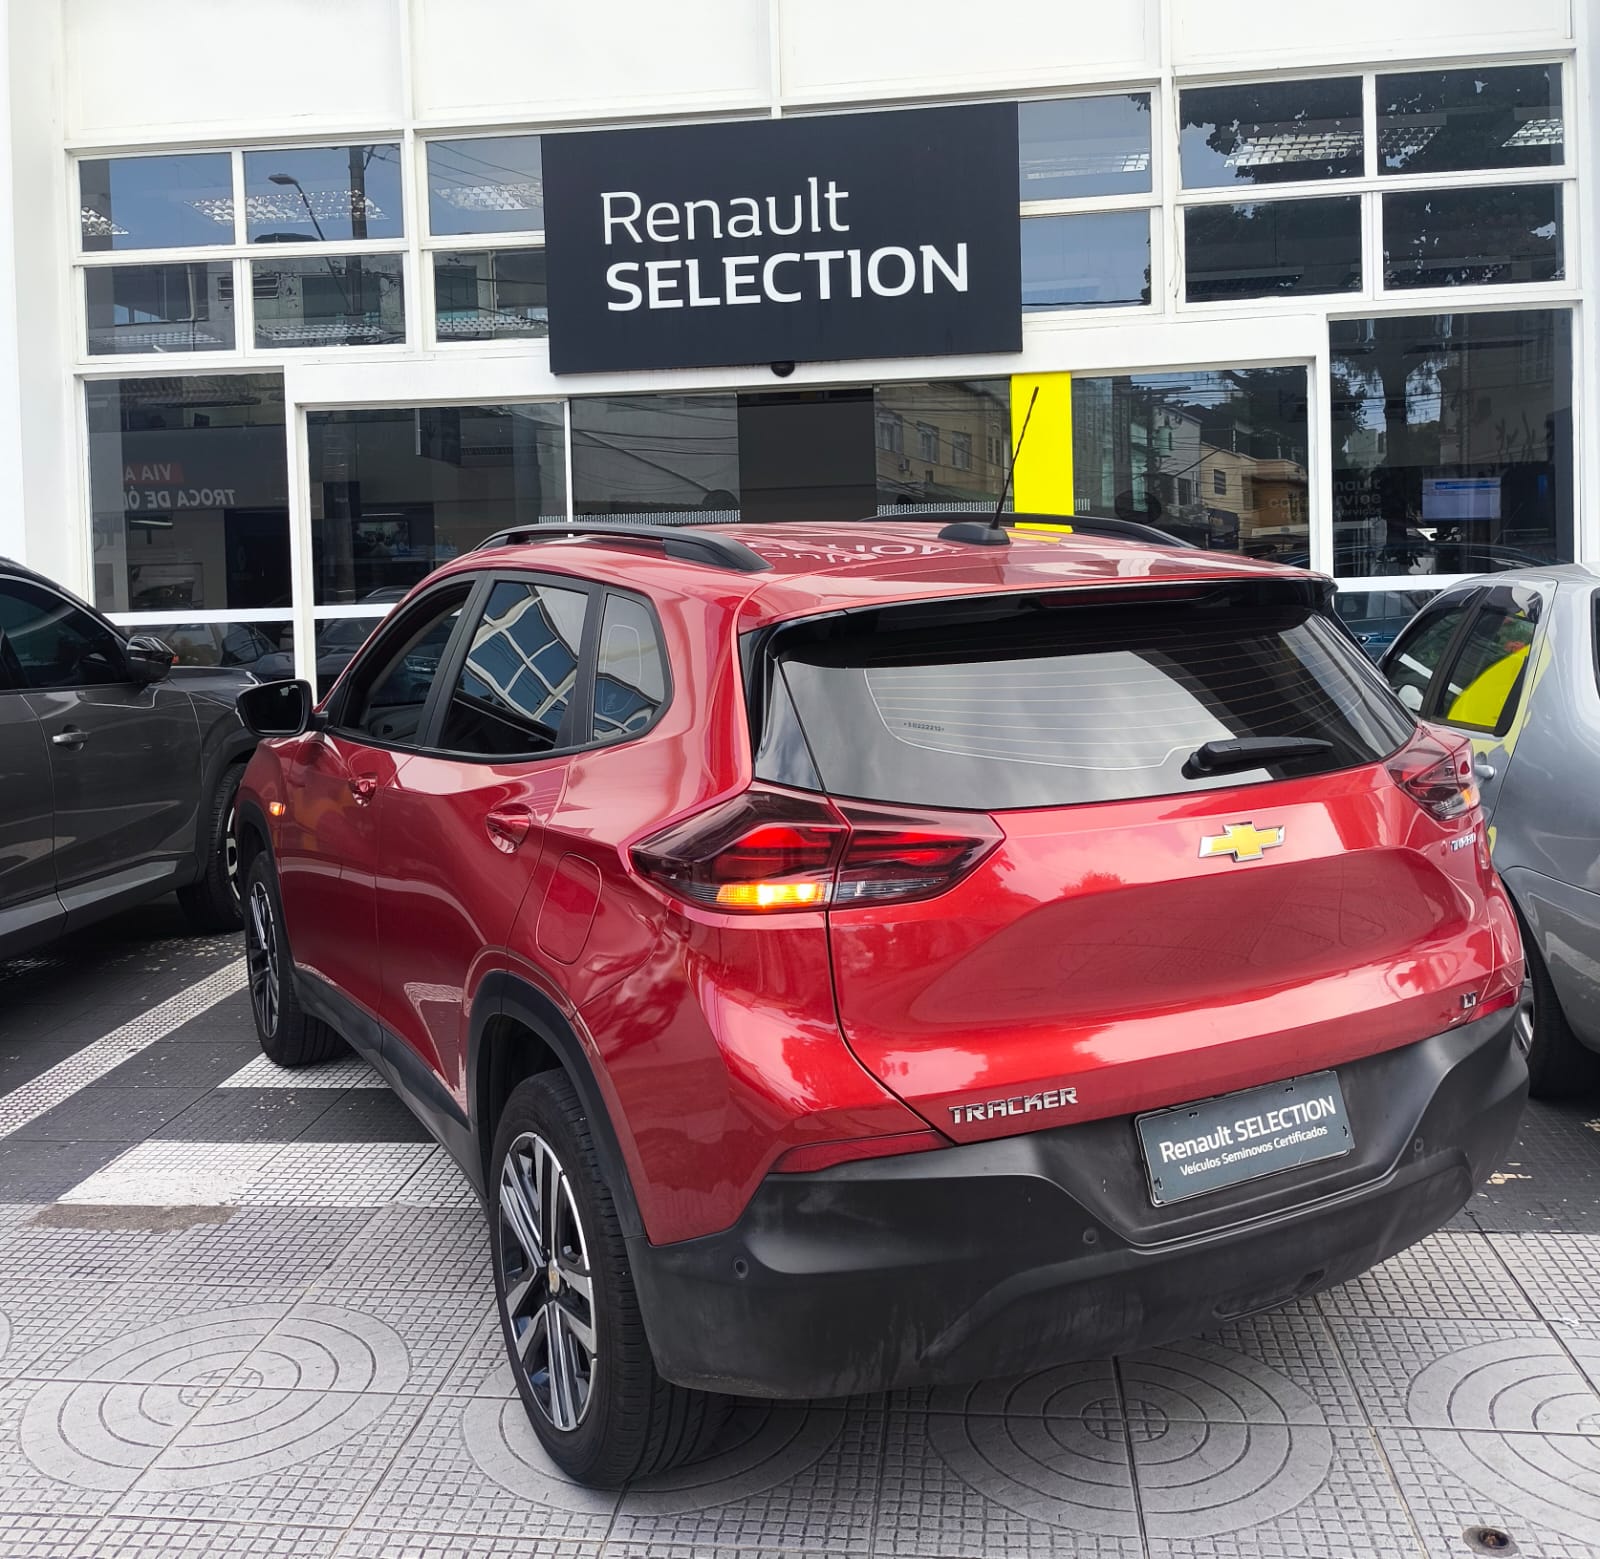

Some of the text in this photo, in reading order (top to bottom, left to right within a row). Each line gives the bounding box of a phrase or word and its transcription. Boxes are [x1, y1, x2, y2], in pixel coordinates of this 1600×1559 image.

[600, 176, 850, 245] Renault
[606, 242, 968, 312] SELECTION
[948, 1087, 1079, 1124] TRACKER
[1159, 1096, 1336, 1163] Renault SELECTION
[1180, 1125, 1328, 1176] Veículos Seminovos Certificados
